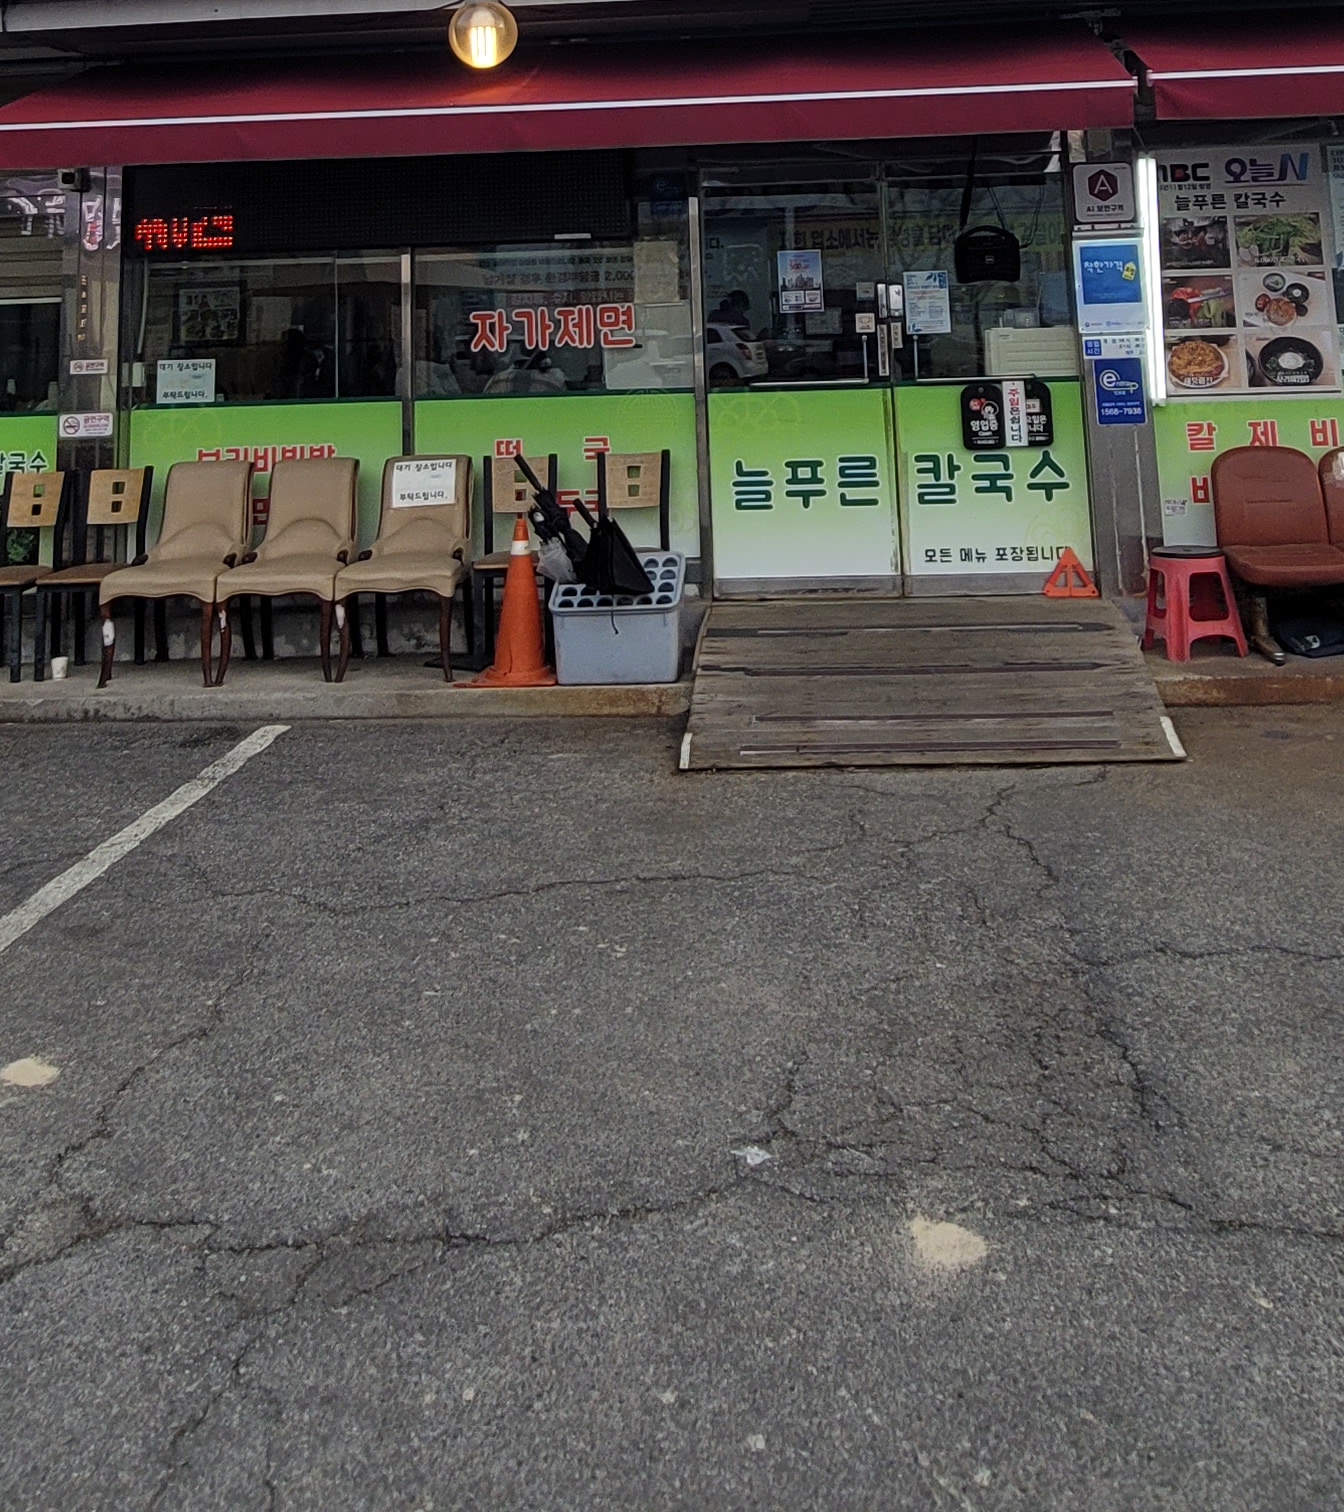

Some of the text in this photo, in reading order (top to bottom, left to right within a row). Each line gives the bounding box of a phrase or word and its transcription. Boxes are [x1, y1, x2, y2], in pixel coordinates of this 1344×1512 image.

[1174, 191, 1286, 211] 늘푸른 칼국수
[1083, 260, 1123, 273] 착한가격
[470, 304, 636, 352] 자가제면
[159, 361, 213, 372] 대기 장소입니다
[161, 390, 209, 400] 부탁드립니다.
[395, 461, 453, 473] 대기 장소입니다
[731, 449, 1071, 511] 늘푸른 칼국수
[399, 490, 449, 502] 부탁드립니다.
[924, 548, 953, 564] 모든
[959, 547, 987, 563] 메뉴
